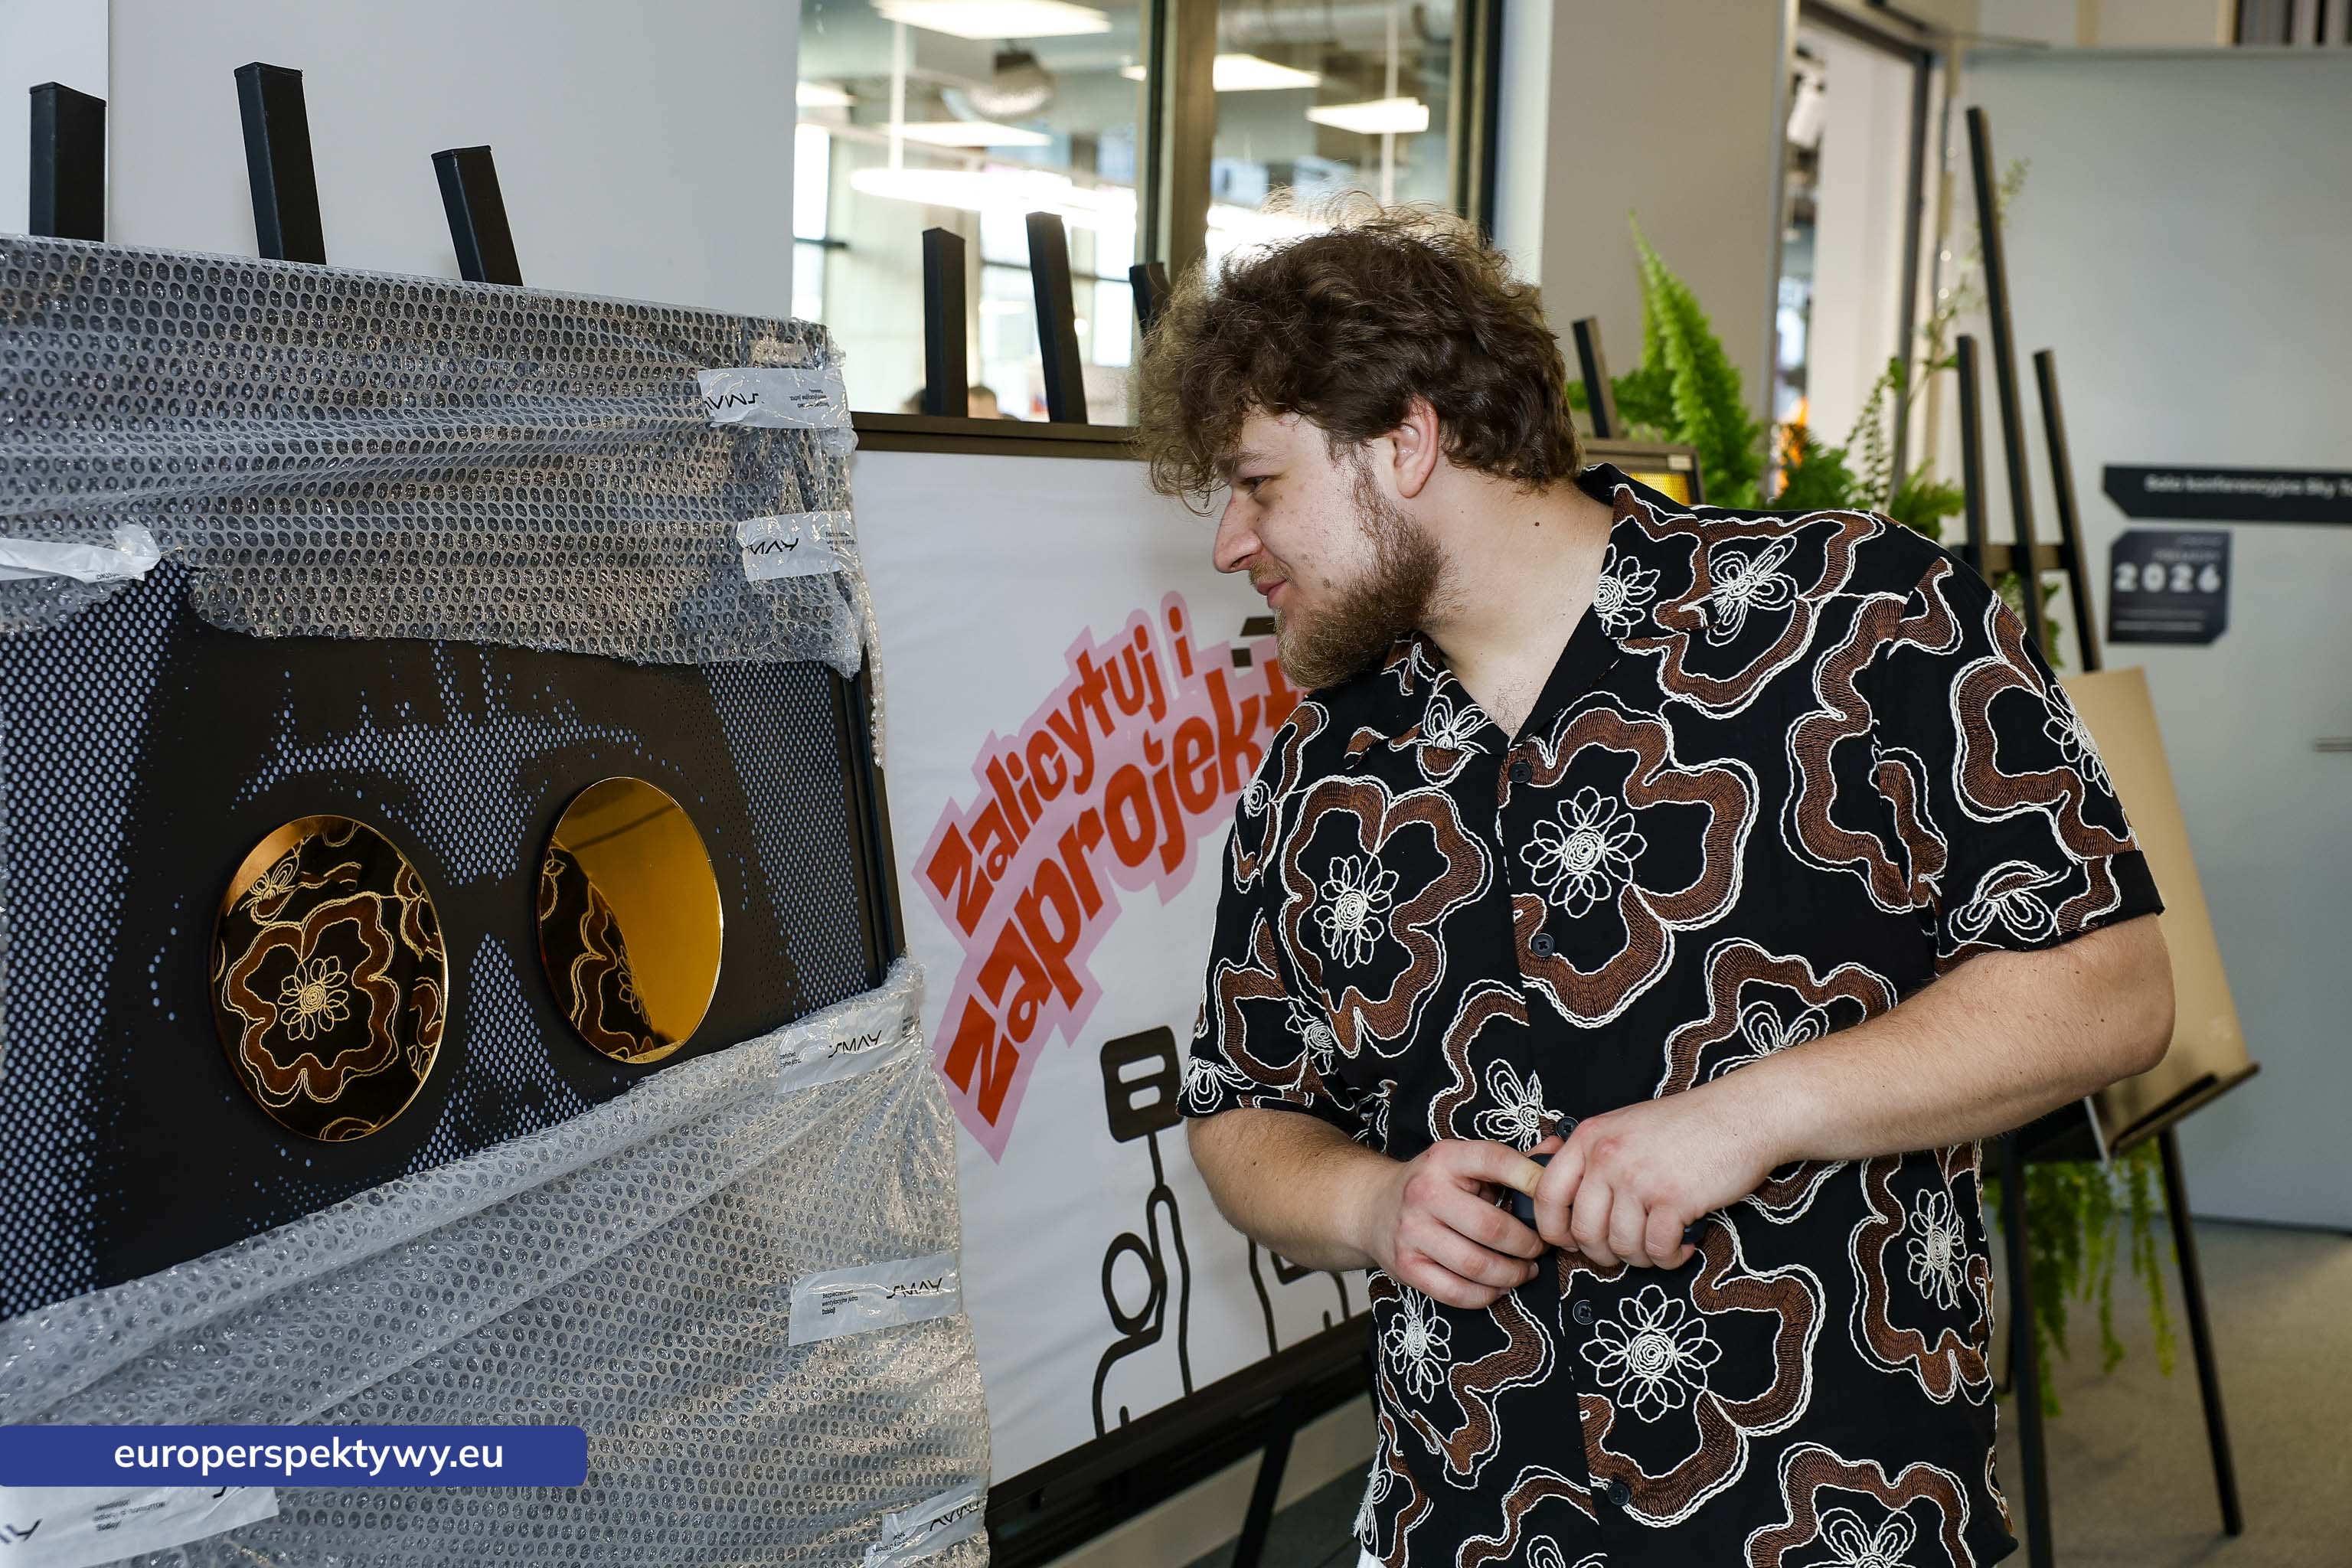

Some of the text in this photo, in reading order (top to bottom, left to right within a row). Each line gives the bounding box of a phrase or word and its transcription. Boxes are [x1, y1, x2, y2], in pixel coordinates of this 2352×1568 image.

[2114, 562, 2220, 593] 2026
[926, 606, 1194, 938] Zalicytuj i
